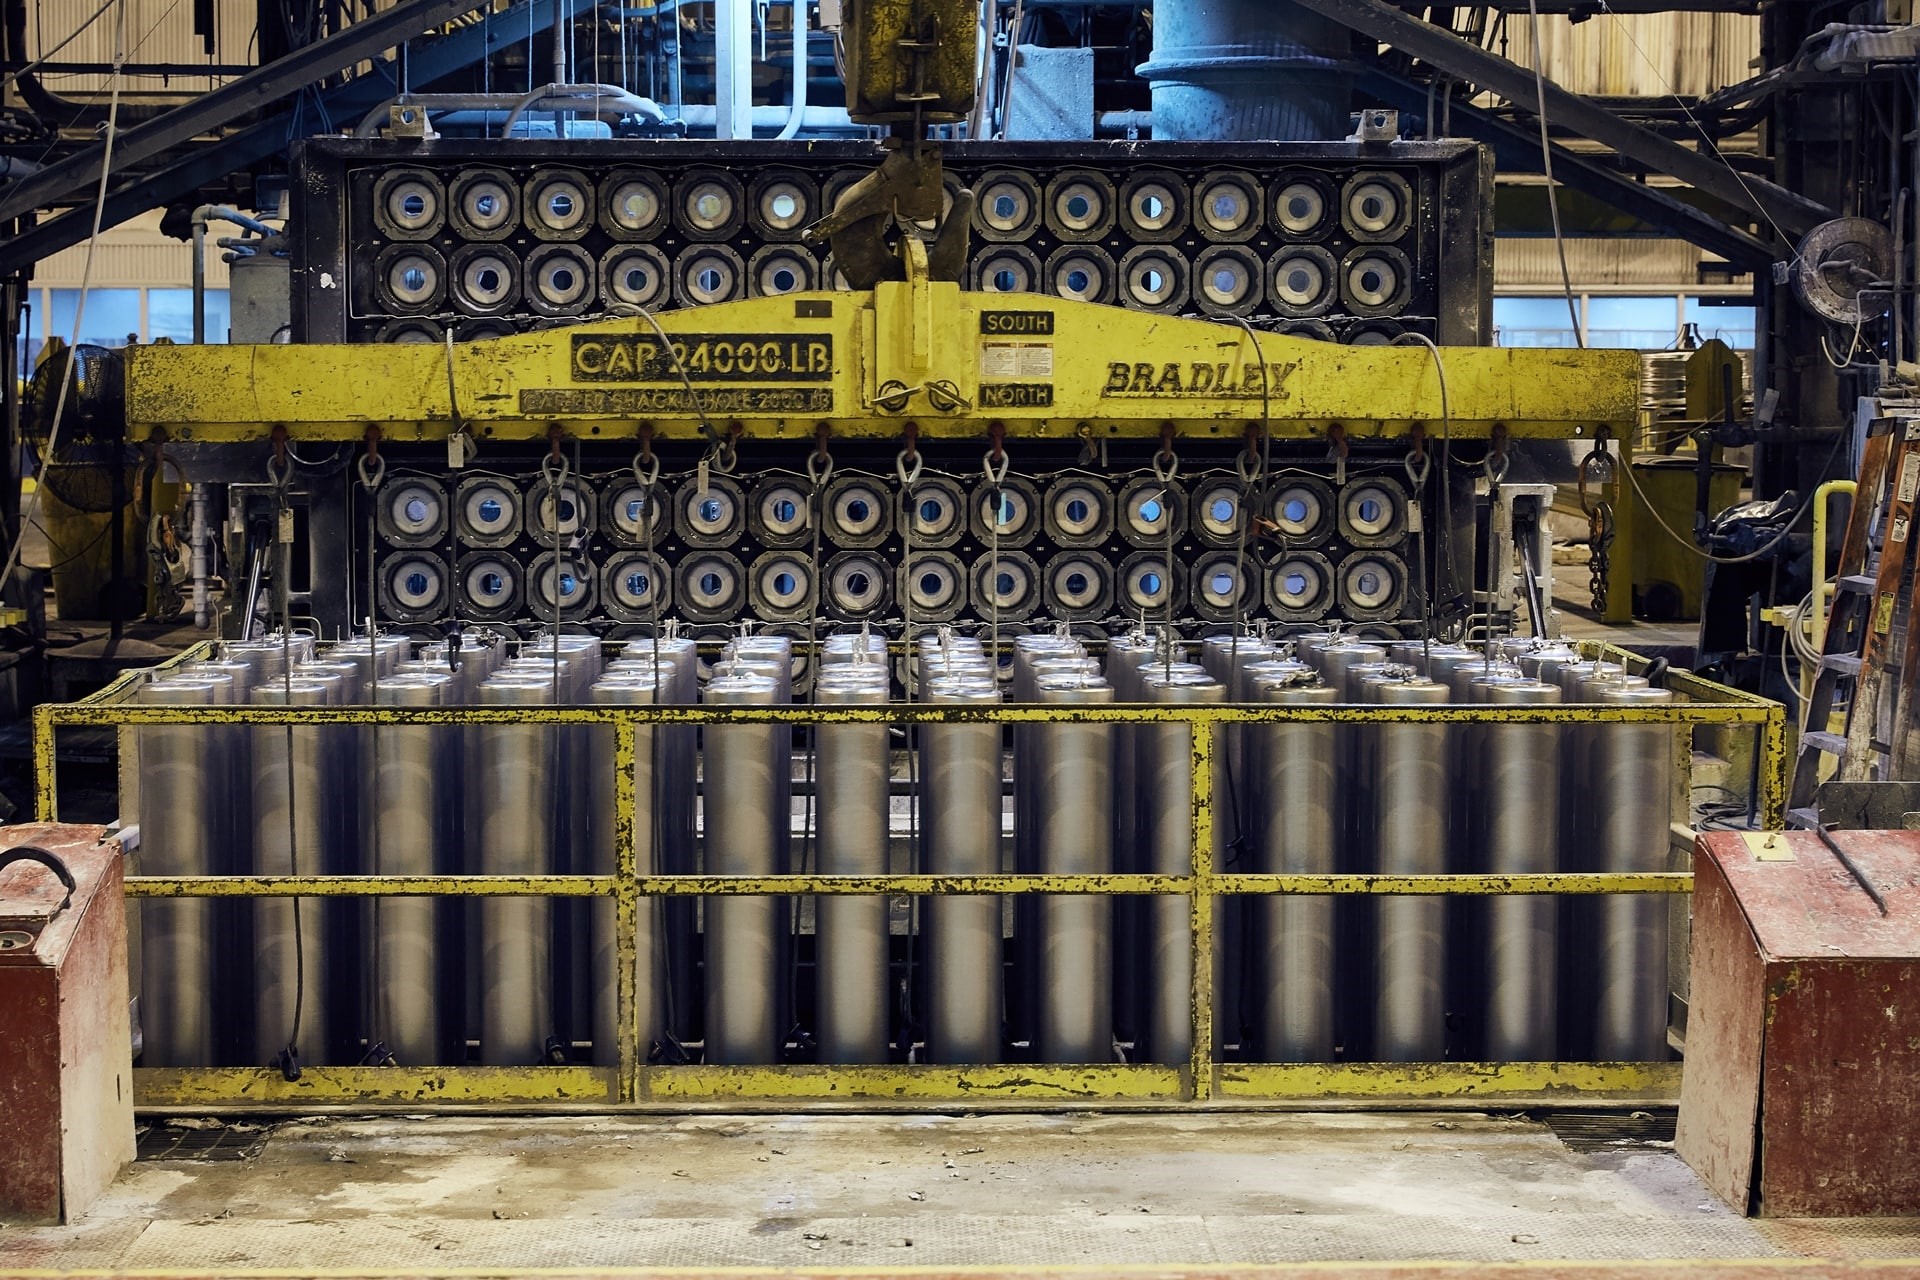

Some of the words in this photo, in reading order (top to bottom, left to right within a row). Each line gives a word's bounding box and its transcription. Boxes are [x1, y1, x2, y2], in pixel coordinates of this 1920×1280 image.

[987, 314, 1048, 331] SOUTH
[576, 342, 657, 374] CAP
[667, 342, 781, 374] 24000
[791, 342, 829, 373] LB
[1102, 360, 1297, 396] BRADLEY
[611, 392, 698, 410] SHACKLE
[703, 393, 752, 410] HOLE
[757, 392, 804, 410] 2000
[810, 391, 830, 410] LB
[985, 387, 1048, 405] NORTH
